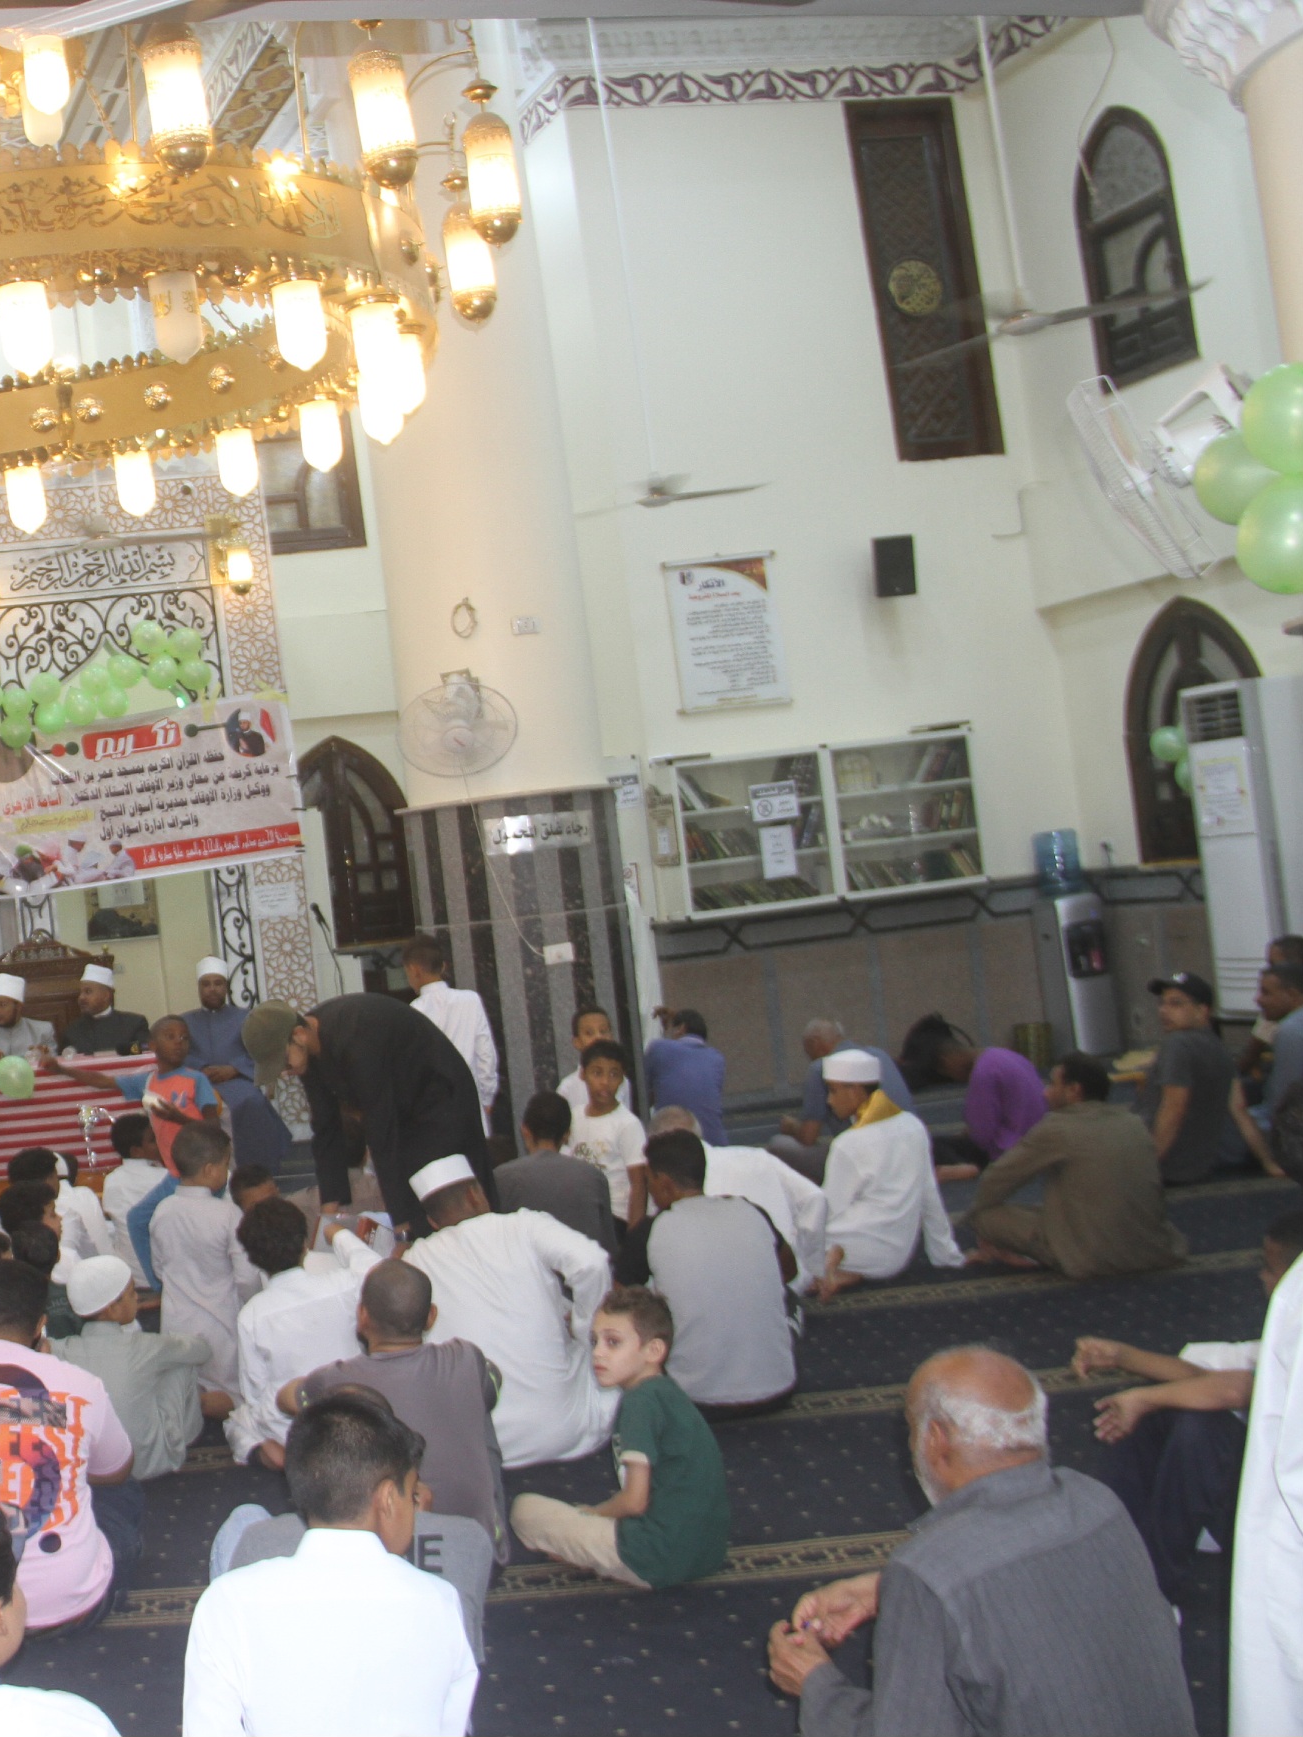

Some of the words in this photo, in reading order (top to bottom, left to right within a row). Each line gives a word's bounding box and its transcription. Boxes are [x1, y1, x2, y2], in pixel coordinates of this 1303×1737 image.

[94, 717, 176, 762] تكريم
[117, 765, 144, 778] بمسجد
[148, 756, 174, 775] الكريم
[98, 769, 113, 783] عمر
[541, 821, 563, 841] غلق
